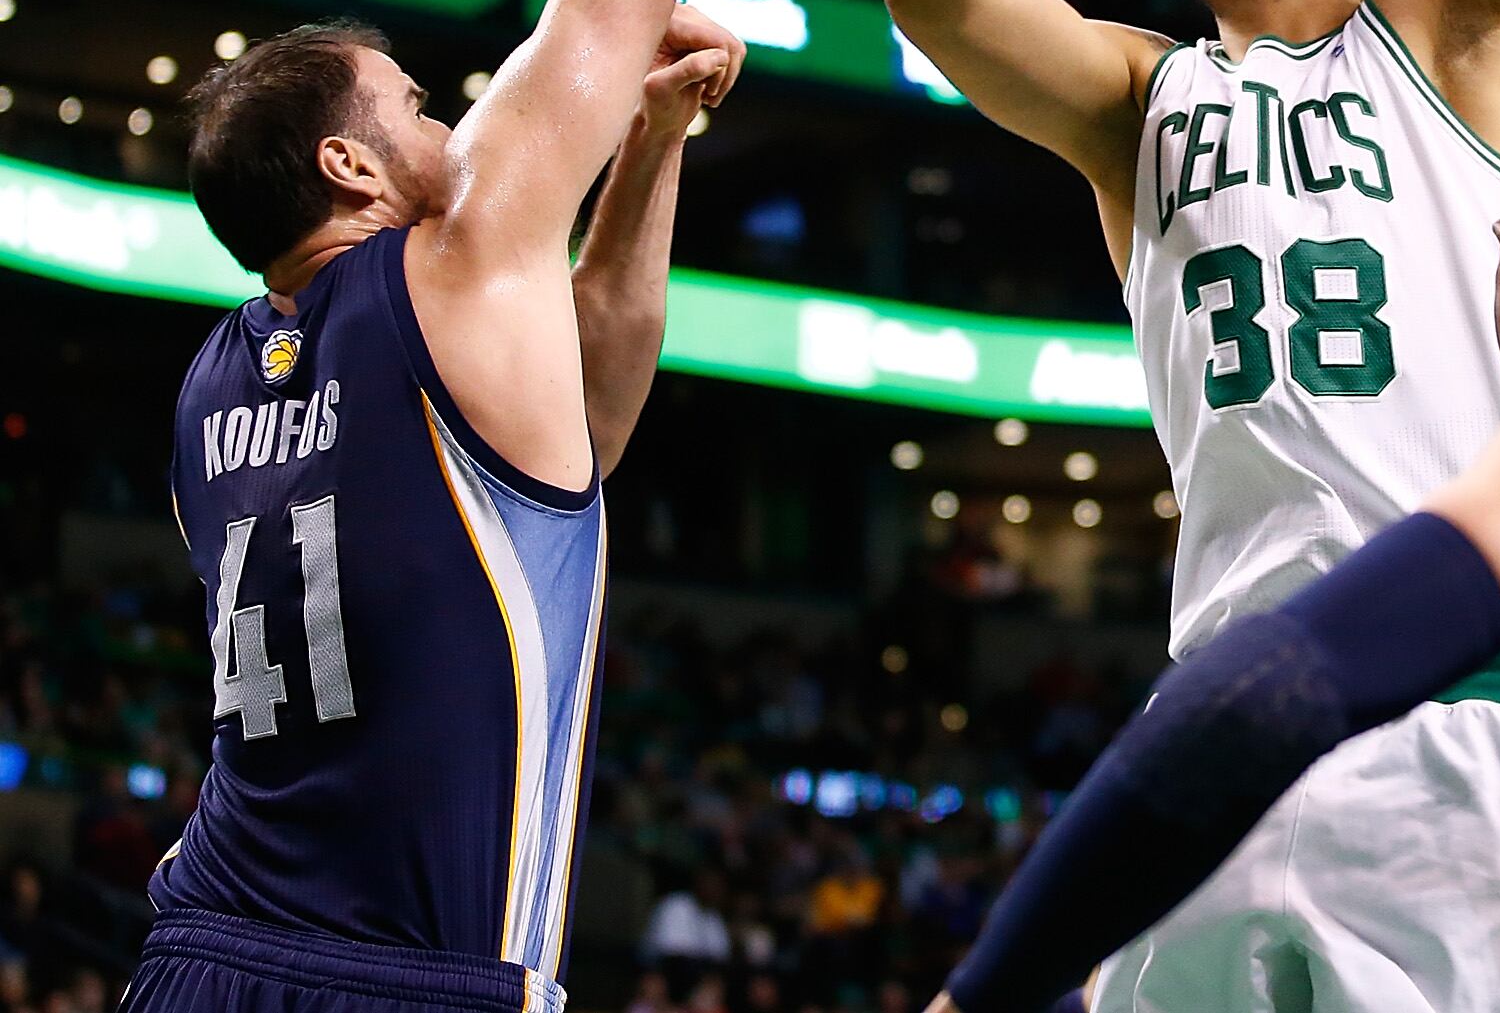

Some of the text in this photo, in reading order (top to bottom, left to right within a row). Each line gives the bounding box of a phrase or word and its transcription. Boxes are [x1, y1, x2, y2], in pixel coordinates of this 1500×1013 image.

[1156, 79, 1394, 237] CELTICS
[1181, 237, 1397, 411] 38
[203, 379, 340, 483] KOUFOS
[212, 494, 357, 741] 41
